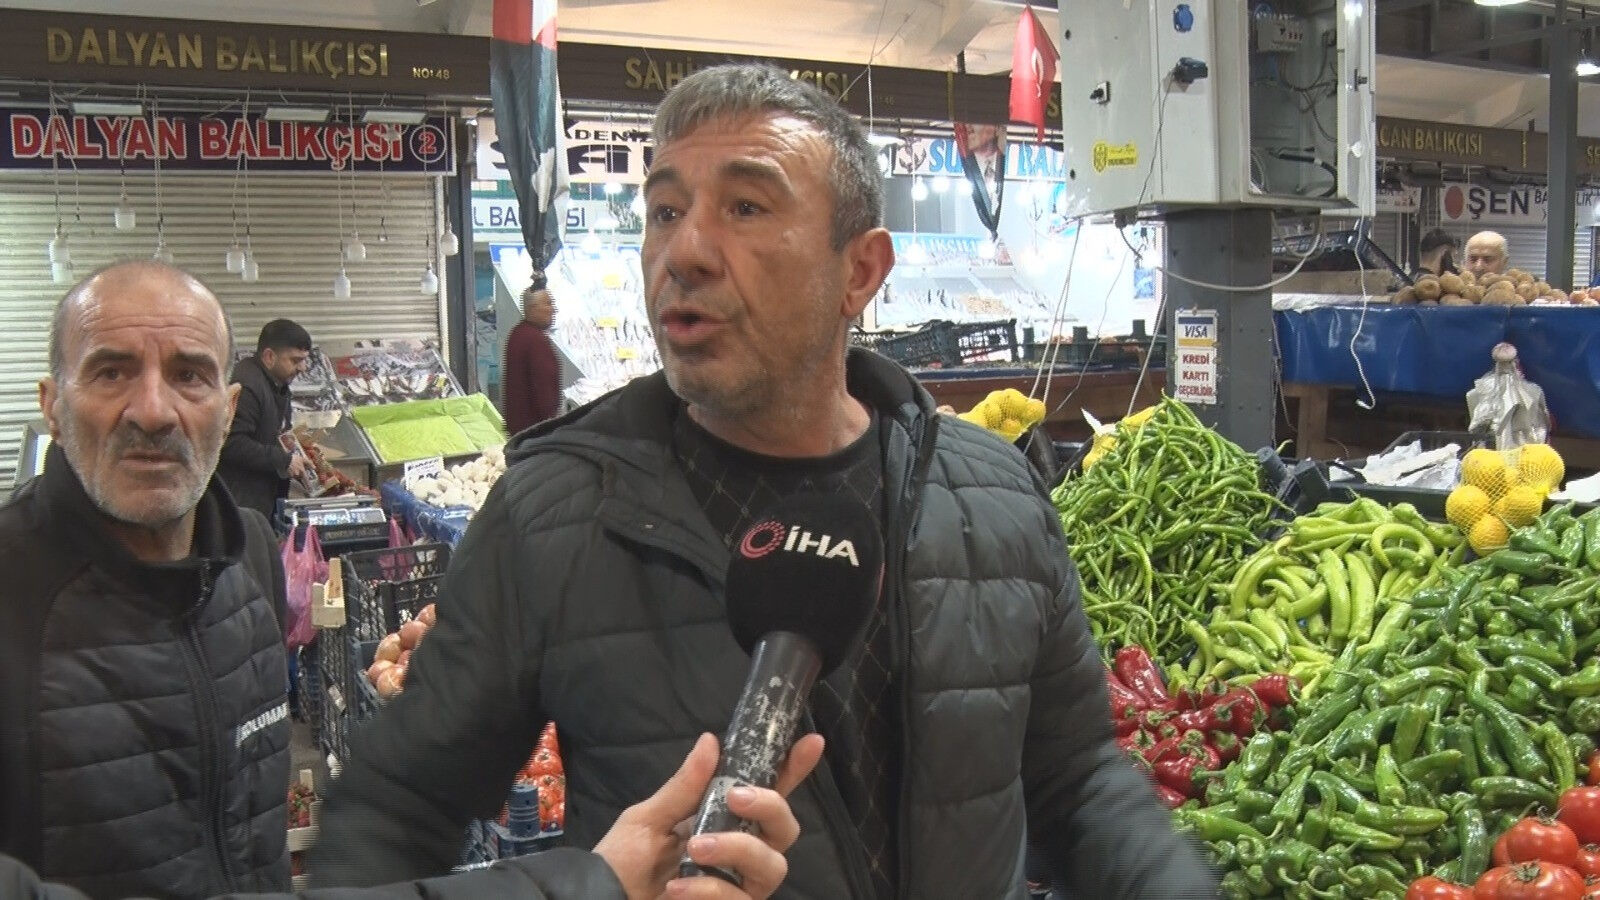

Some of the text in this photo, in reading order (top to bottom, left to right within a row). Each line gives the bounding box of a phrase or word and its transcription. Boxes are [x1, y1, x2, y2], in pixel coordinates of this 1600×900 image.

[47, 27, 201, 69] DALYAN
[216, 35, 389, 79] BALIKÇISI
[11, 114, 437, 170] DALYAN BALIKÇISI 2
[1415, 129, 1483, 156] BALIKÇISI
[1468, 188, 1530, 220] ŞEN
[1184, 325, 1208, 338] VISA
[1182, 353, 1210, 365] KREDİ
[1182, 371, 1209, 381] KARTI
[784, 526, 860, 568] İHA
